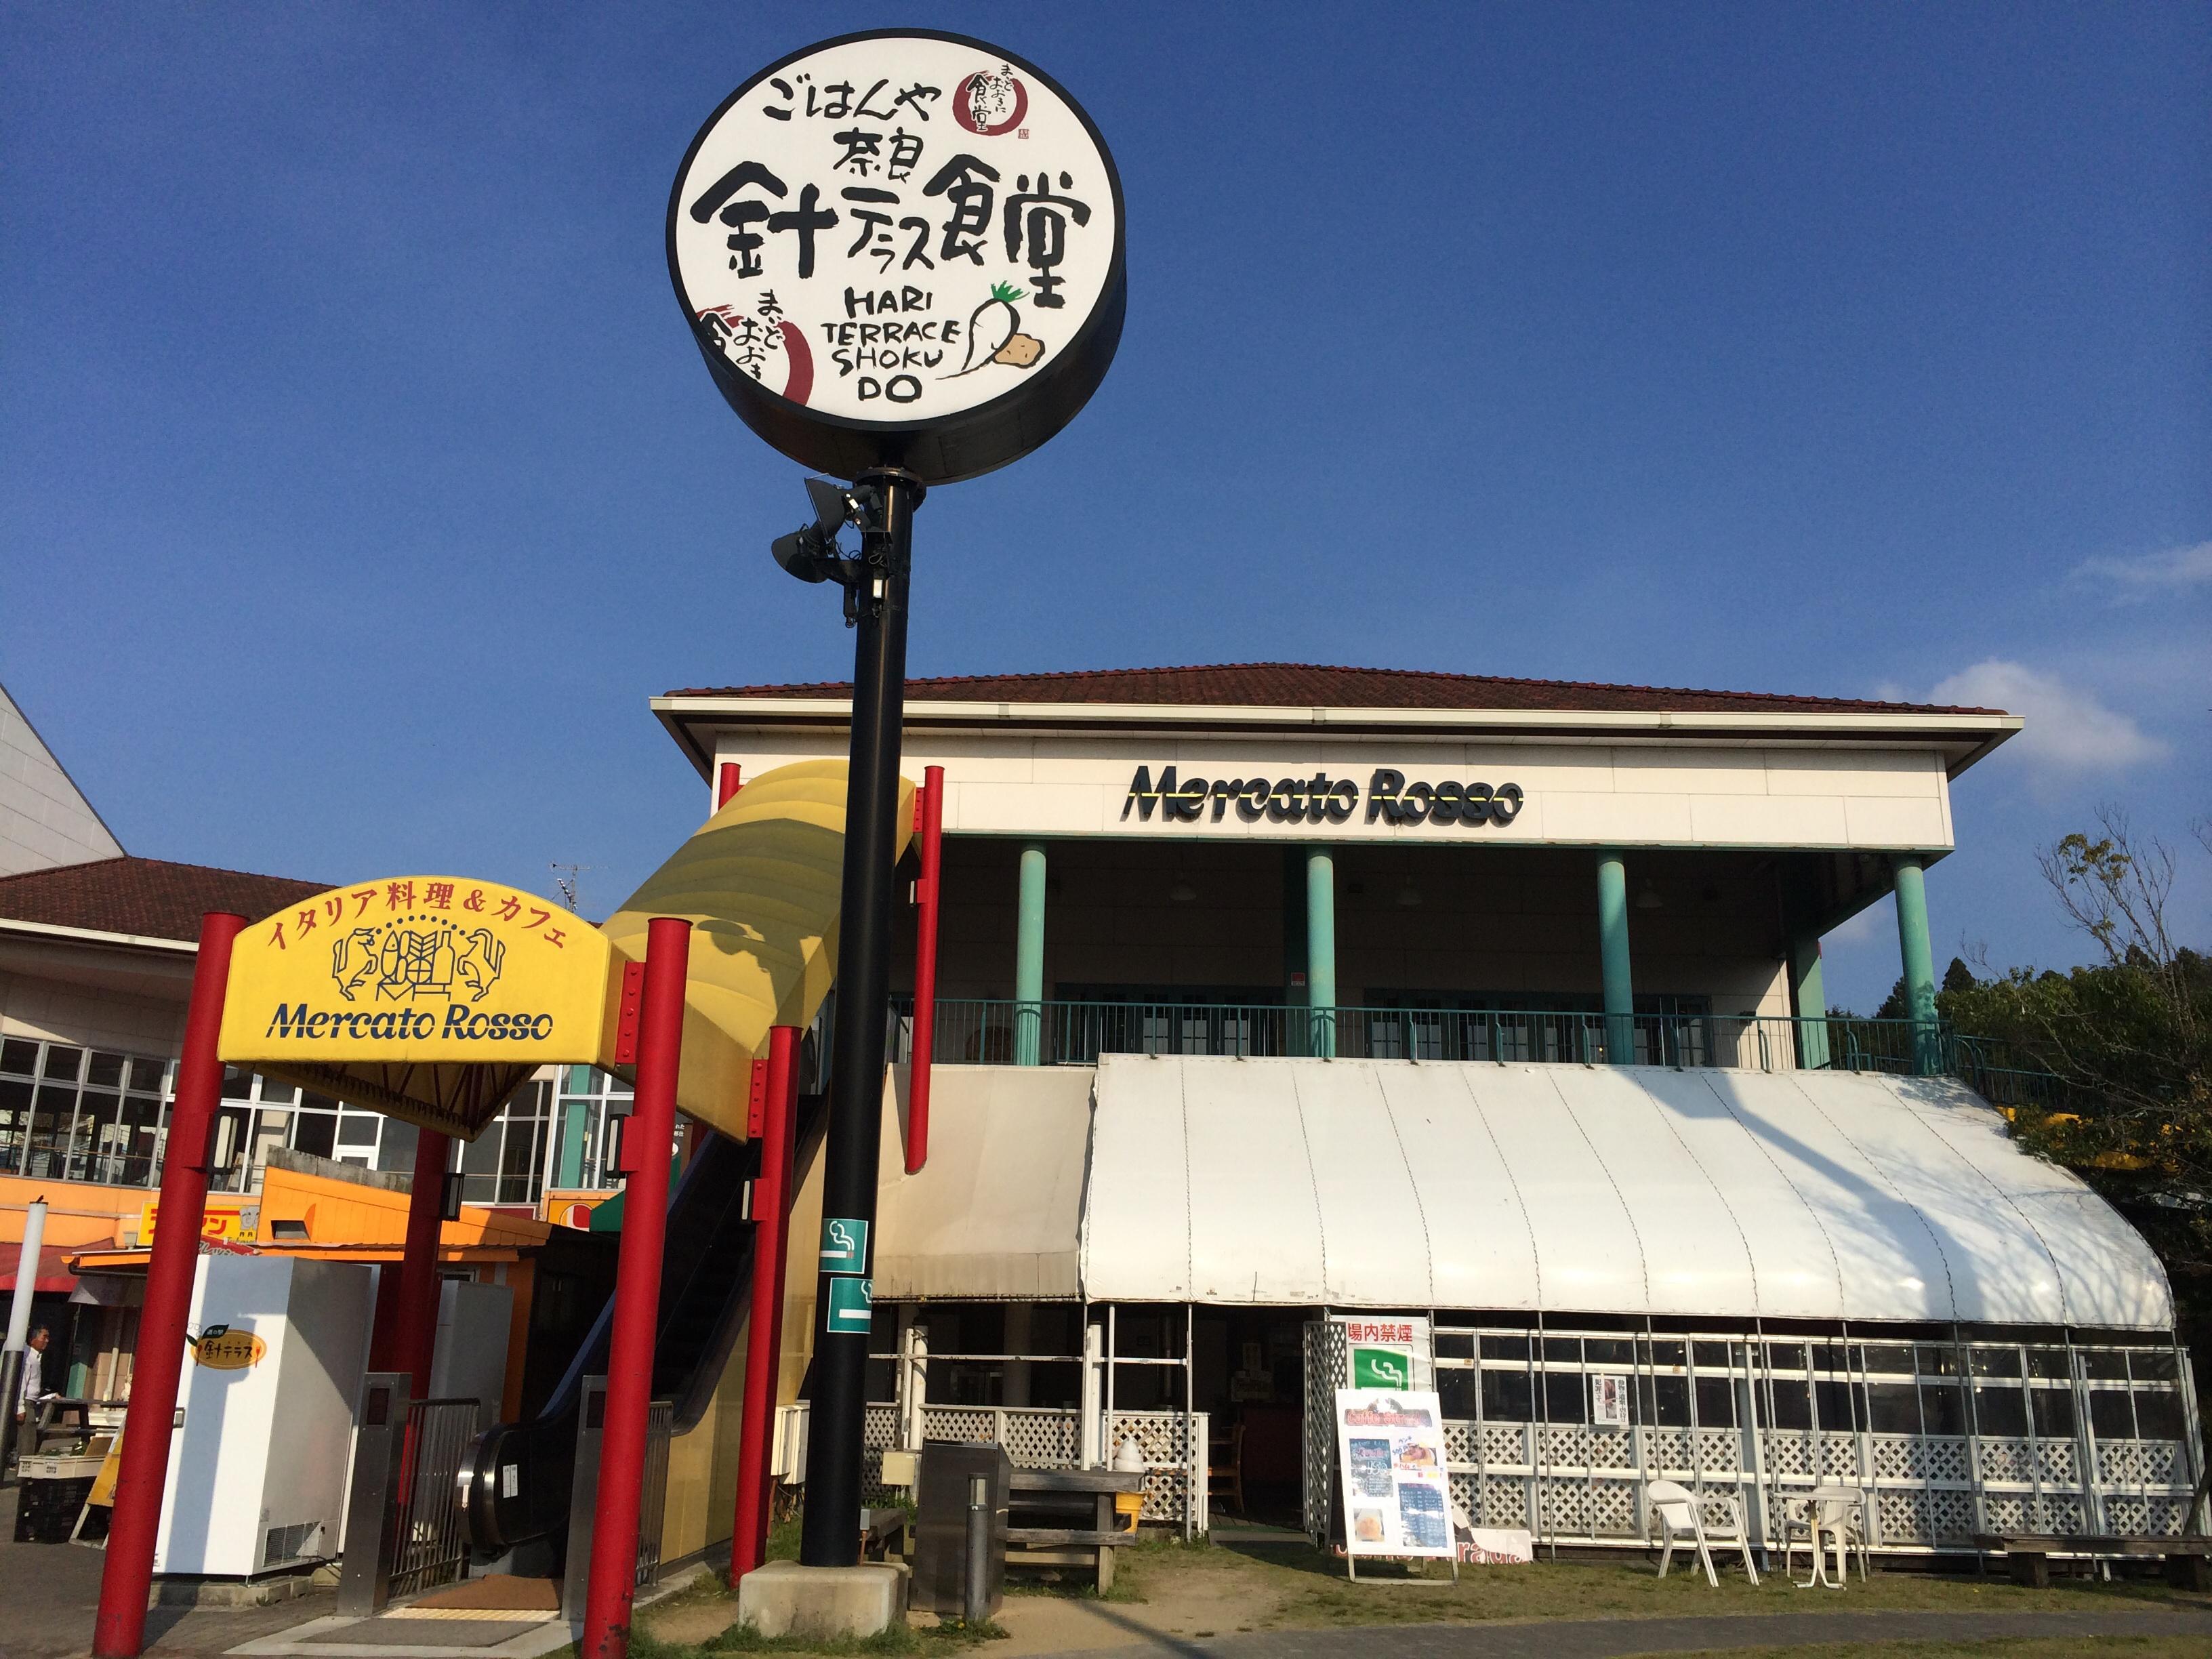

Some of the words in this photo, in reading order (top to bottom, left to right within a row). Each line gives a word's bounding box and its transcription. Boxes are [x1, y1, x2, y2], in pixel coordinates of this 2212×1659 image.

[763, 74, 941, 121] ごはんや
[966, 74, 991, 131] 食堂
[833, 127, 924, 184] 奈良
[844, 287, 933, 319] HARI
[821, 320, 962, 346] TERRACE
[834, 346, 943, 377] SHOKU
[857, 373, 922, 403] DO
[1122, 765, 1358, 821] Mercato
[1366, 768, 1524, 823] Rosso
[265, 1003, 436, 1040] Mercato
[441, 1004, 554, 1040] Rosso
[1347, 1323, 1413, 1343] 場内禁煙
[204, 1340, 253, 1359] 針テラス
